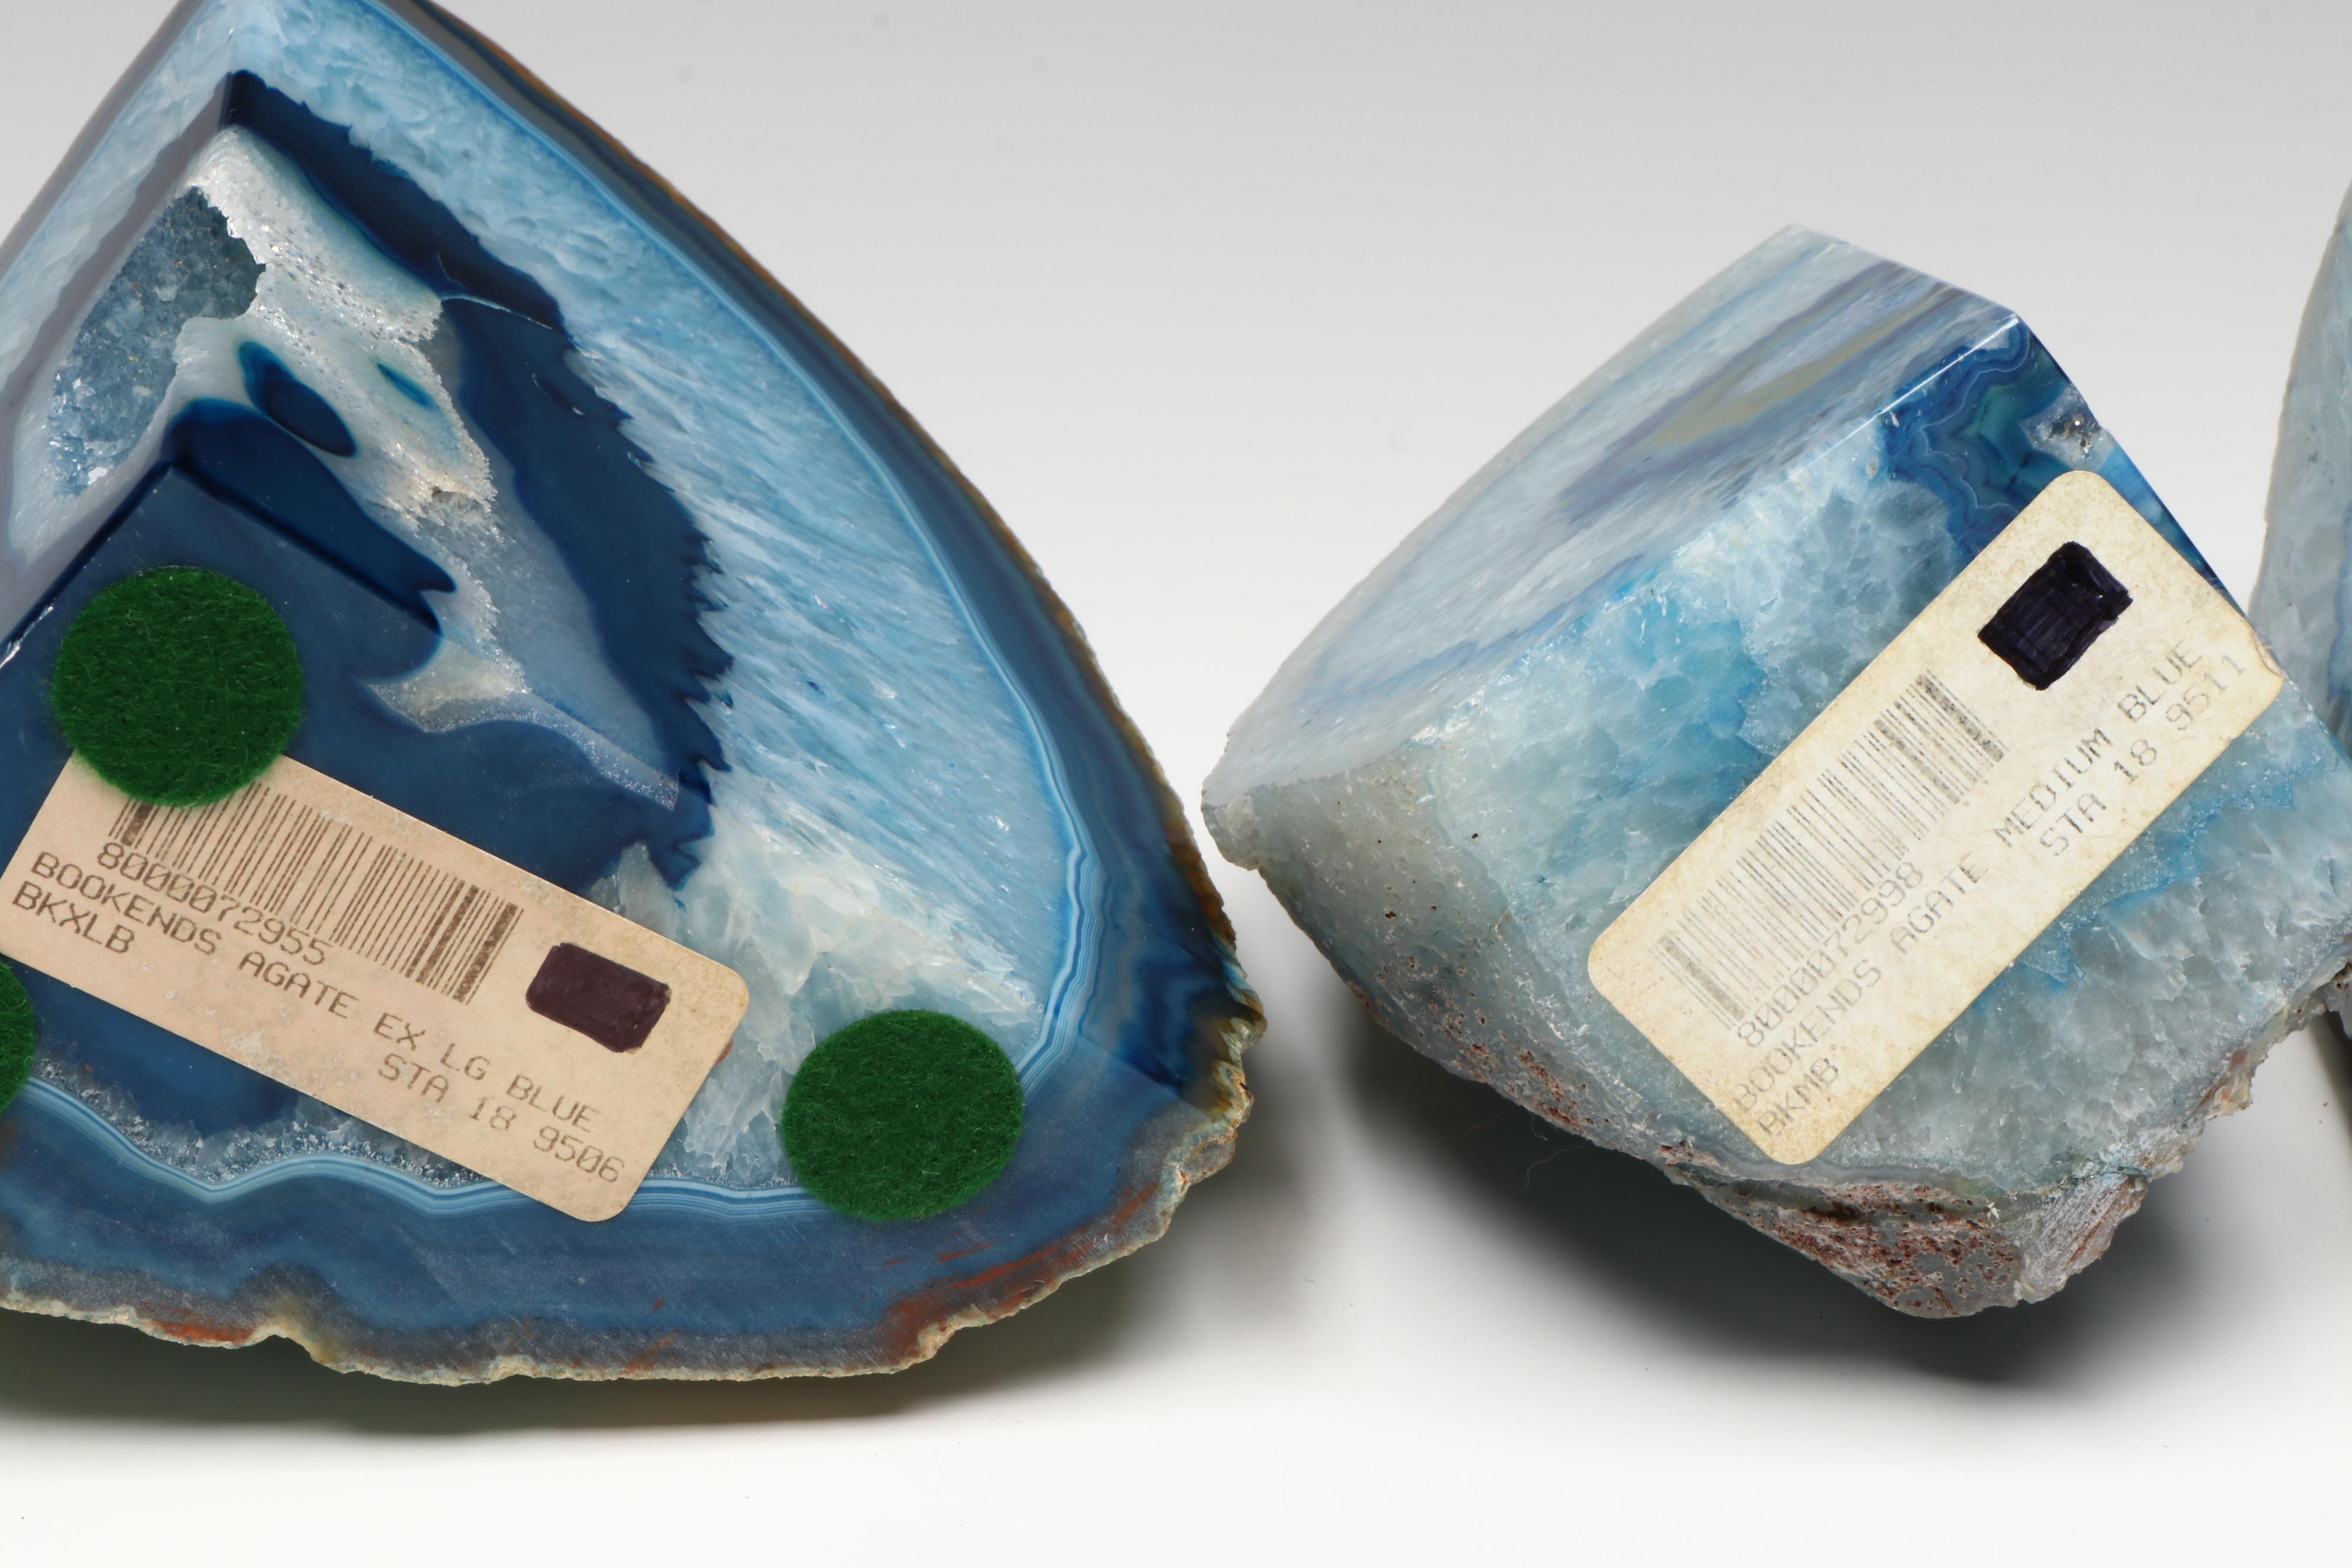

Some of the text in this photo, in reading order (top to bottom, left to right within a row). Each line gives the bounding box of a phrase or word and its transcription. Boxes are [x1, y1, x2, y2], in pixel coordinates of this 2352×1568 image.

[31, 851, 600, 1132] BOOKENDS AGATE EX LG BLUE
[97, 842, 332, 965] 8000072955
[1732, 639, 2202, 1112] BOOKENDS AGATE MEDIUM BLUE
[1737, 861, 1923, 1047] 8000072998
[1756, 654, 2245, 1135] BKMB STA 18 9511
[12, 881, 625, 1182] BKXLB STA 18 9506
